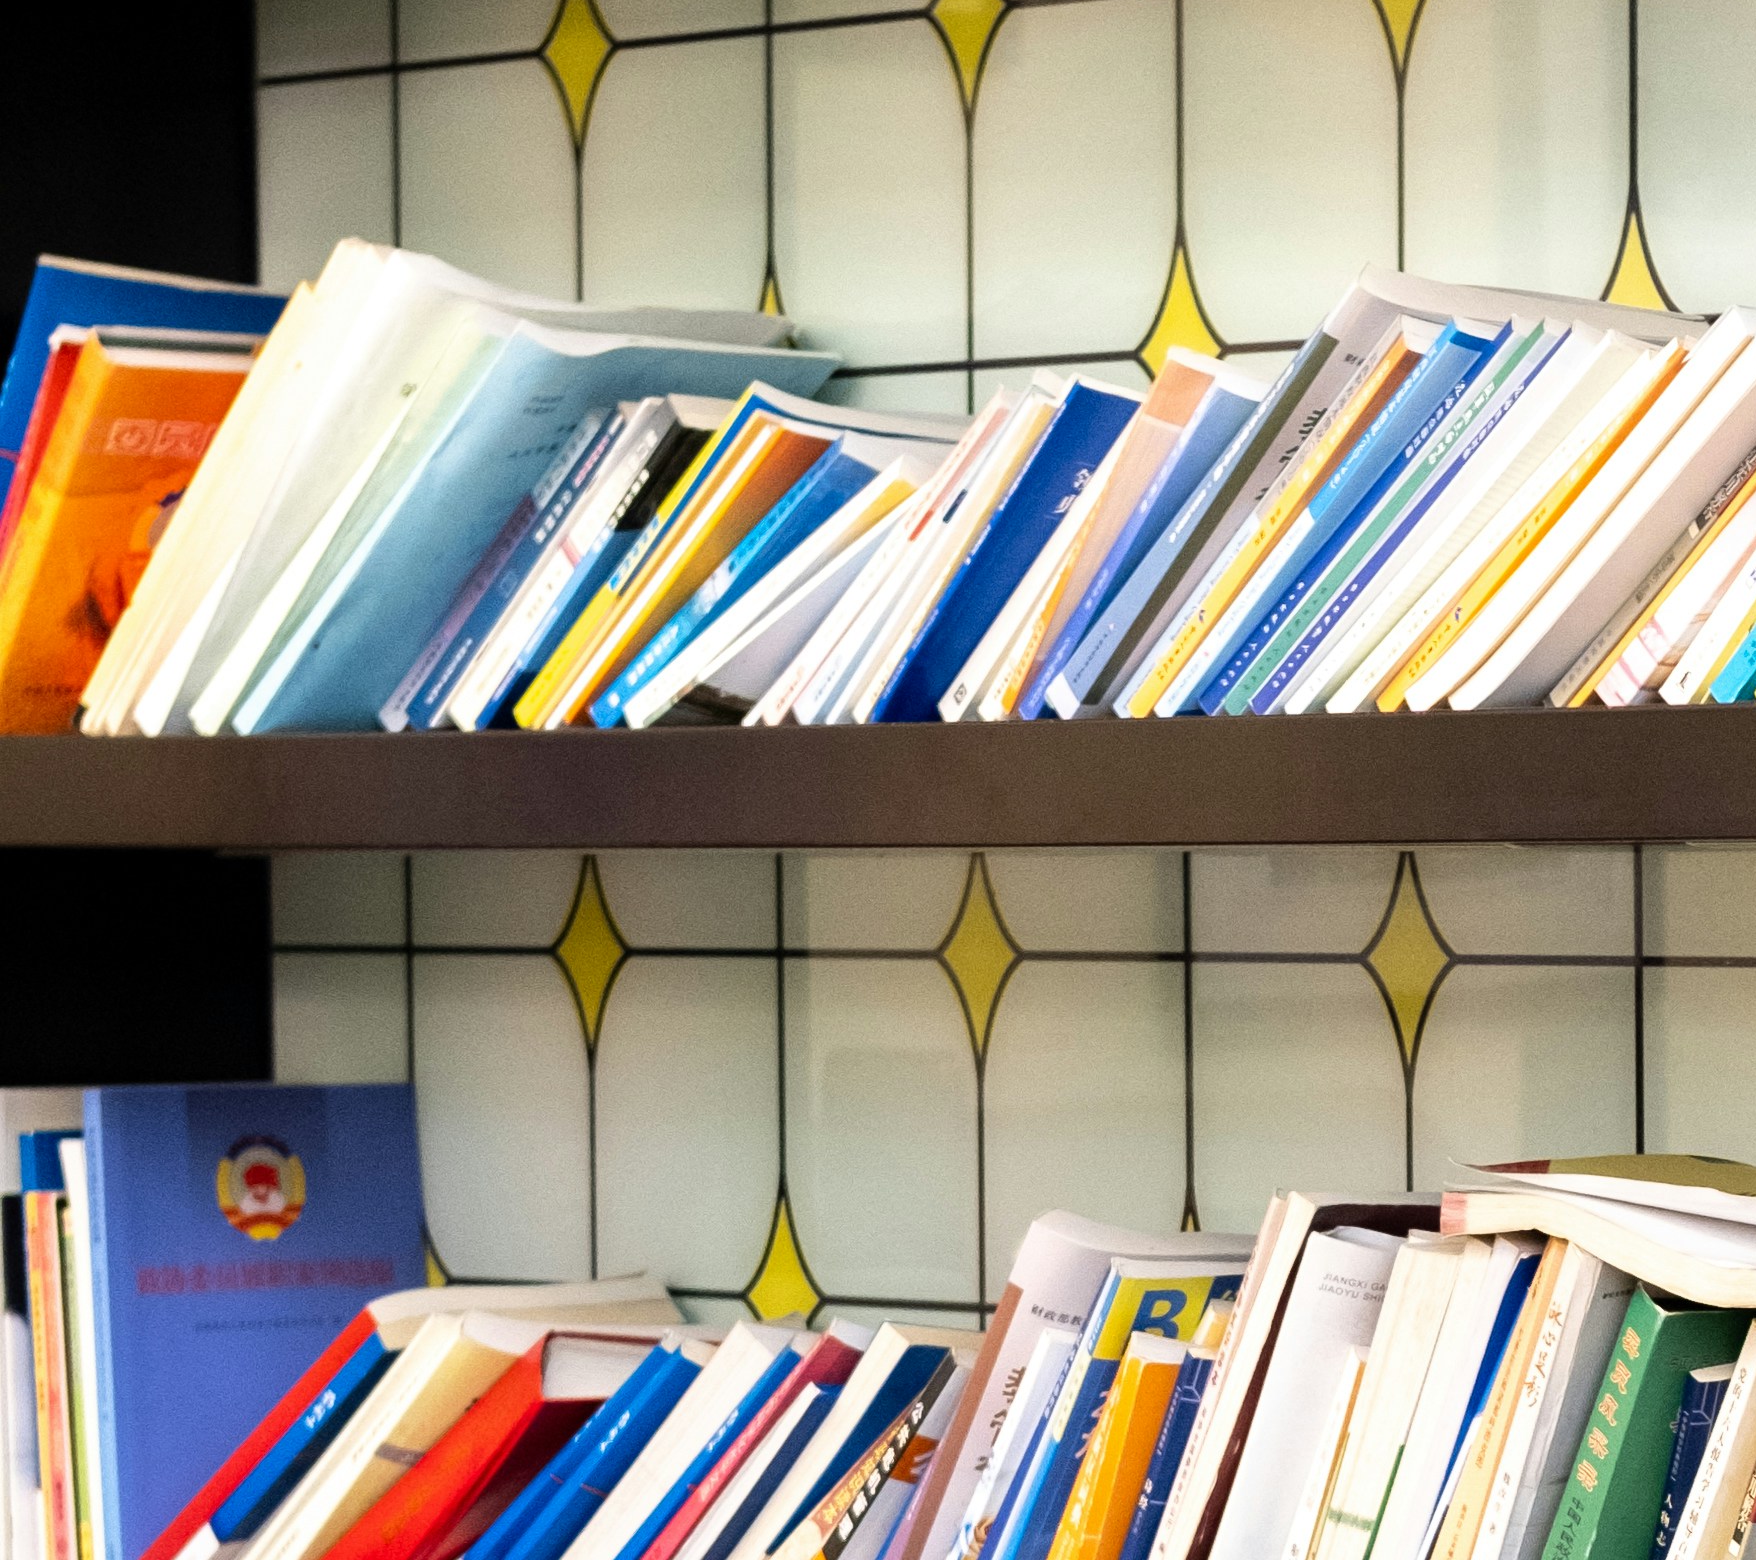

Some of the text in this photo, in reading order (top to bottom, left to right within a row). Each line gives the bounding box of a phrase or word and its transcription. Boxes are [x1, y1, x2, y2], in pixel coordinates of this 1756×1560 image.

[1322, 1272, 1366, 1290] JIANGXI
[1318, 1282, 1360, 1301] JIAOYU
[1131, 1289, 1188, 1342] B
